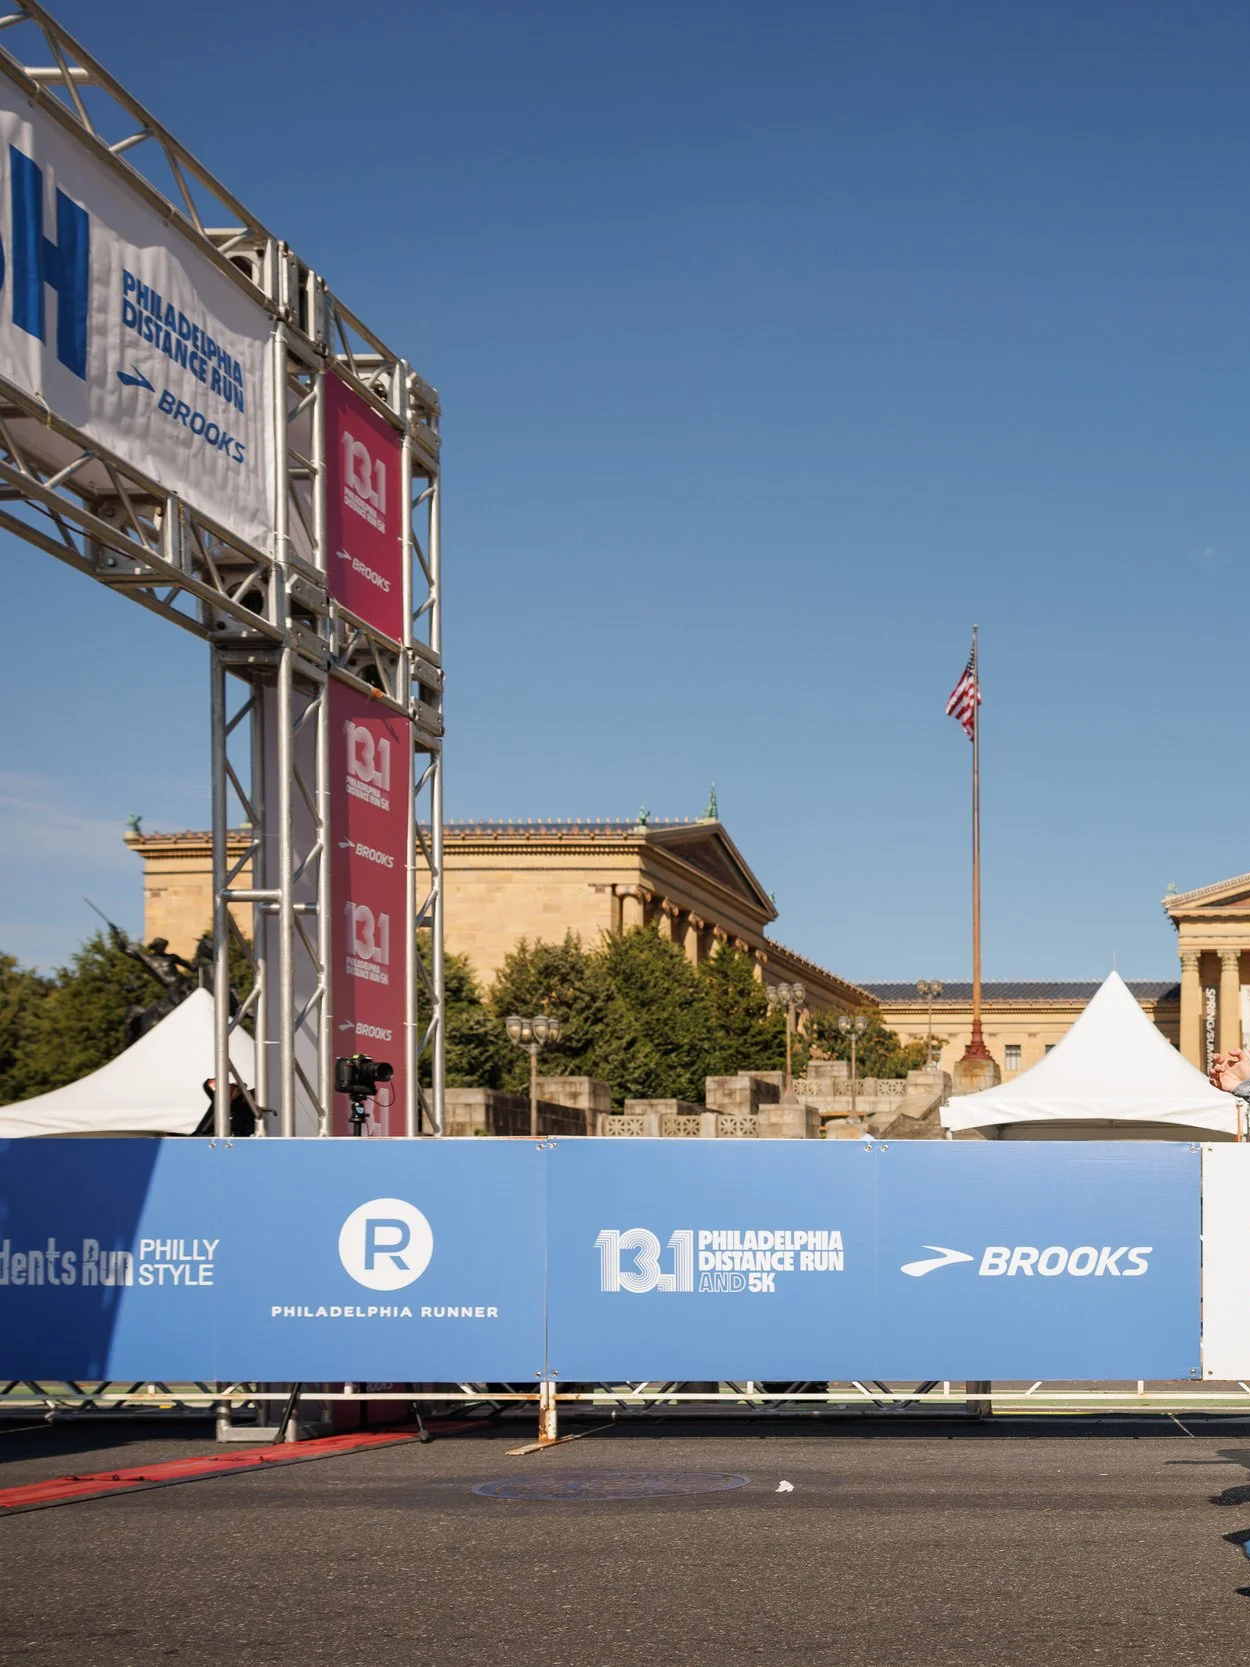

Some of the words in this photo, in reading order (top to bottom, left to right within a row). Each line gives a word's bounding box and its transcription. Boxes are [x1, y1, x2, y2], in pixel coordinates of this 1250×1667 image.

[122, 268, 244, 388] PHILADELPHIA
[121, 297, 207, 383] DISTANCE
[210, 365, 245, 413] RUN
[157, 389, 246, 464] BROOKS
[351, 557, 392, 593] BROOKS
[355, 843, 395, 869] BROOKS
[355, 1022, 393, 1041] BROOKS
[139, 1239, 220, 1261] PHILLY
[364, 1218, 411, 1270] R
[698, 1230, 844, 1251] PHILADELPHIA
[81, 1238, 135, 1287] Run
[698, 1251, 794, 1271] DISTANCE
[799, 1251, 845, 1271] RUN
[977, 1246, 1154, 1277] BROOKS
[137, 1264, 214, 1286] STYLE
[698, 1272, 746, 1293] AND
[747, 1272, 776, 1293] 5K
[271, 1306, 413, 1318] PHILADELPHIA
[420, 1306, 499, 1318] RUNNER
